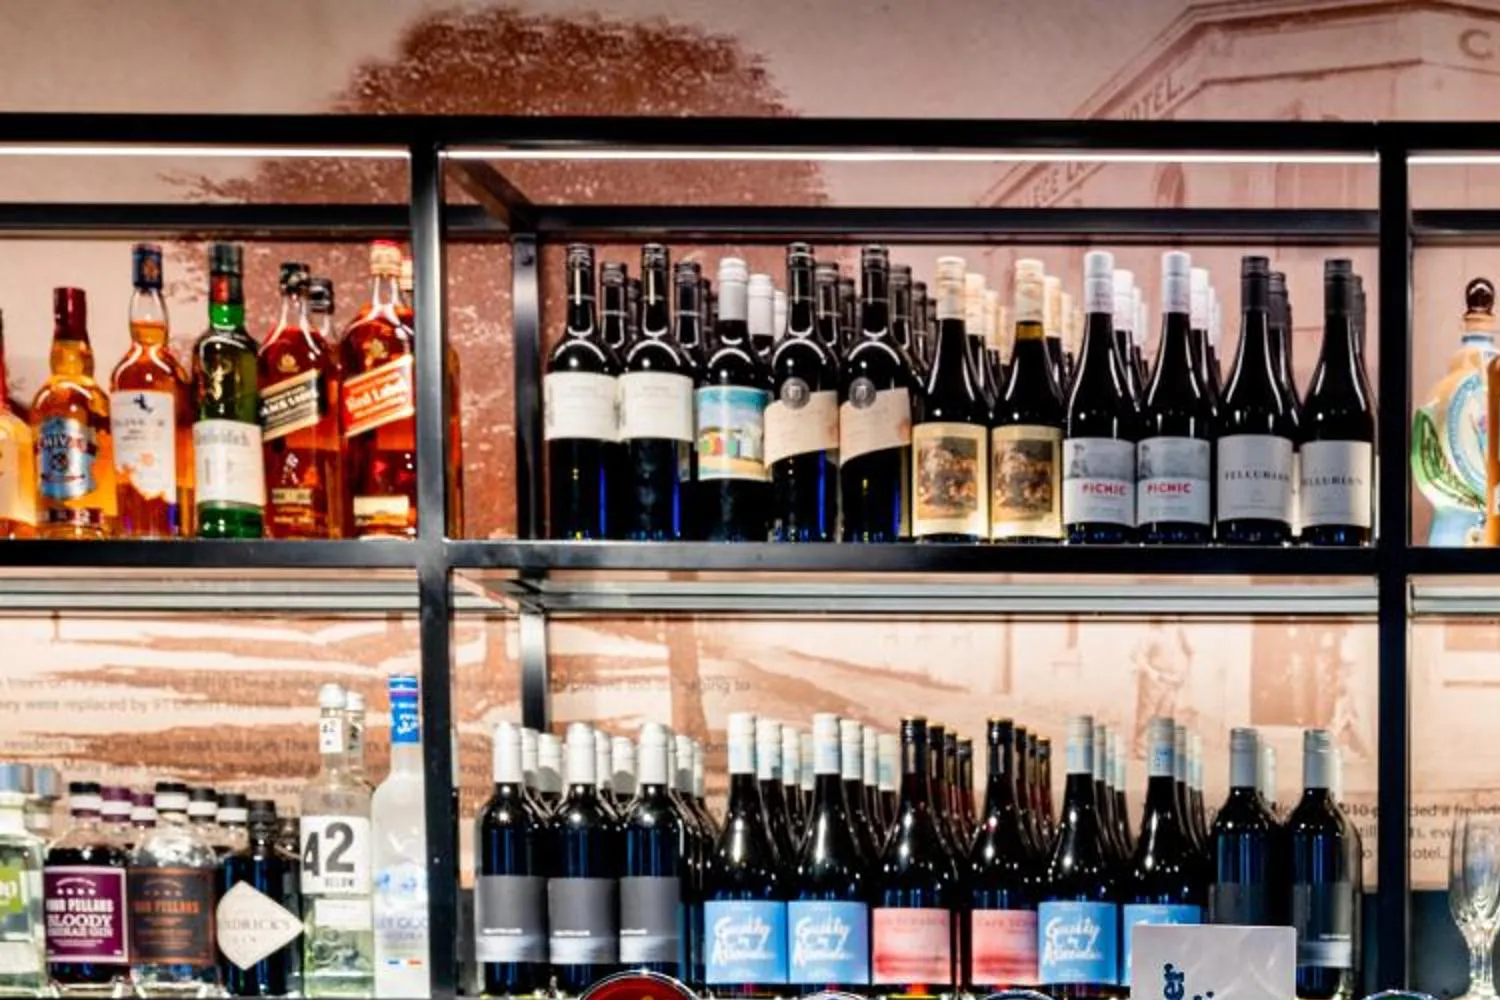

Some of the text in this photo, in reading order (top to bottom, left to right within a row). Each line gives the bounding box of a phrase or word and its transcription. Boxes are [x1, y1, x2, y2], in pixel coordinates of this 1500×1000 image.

[1082, 483, 1127, 497] PICNIC
[1147, 483, 1193, 495] PICNIC
[303, 822, 355, 876] 42
